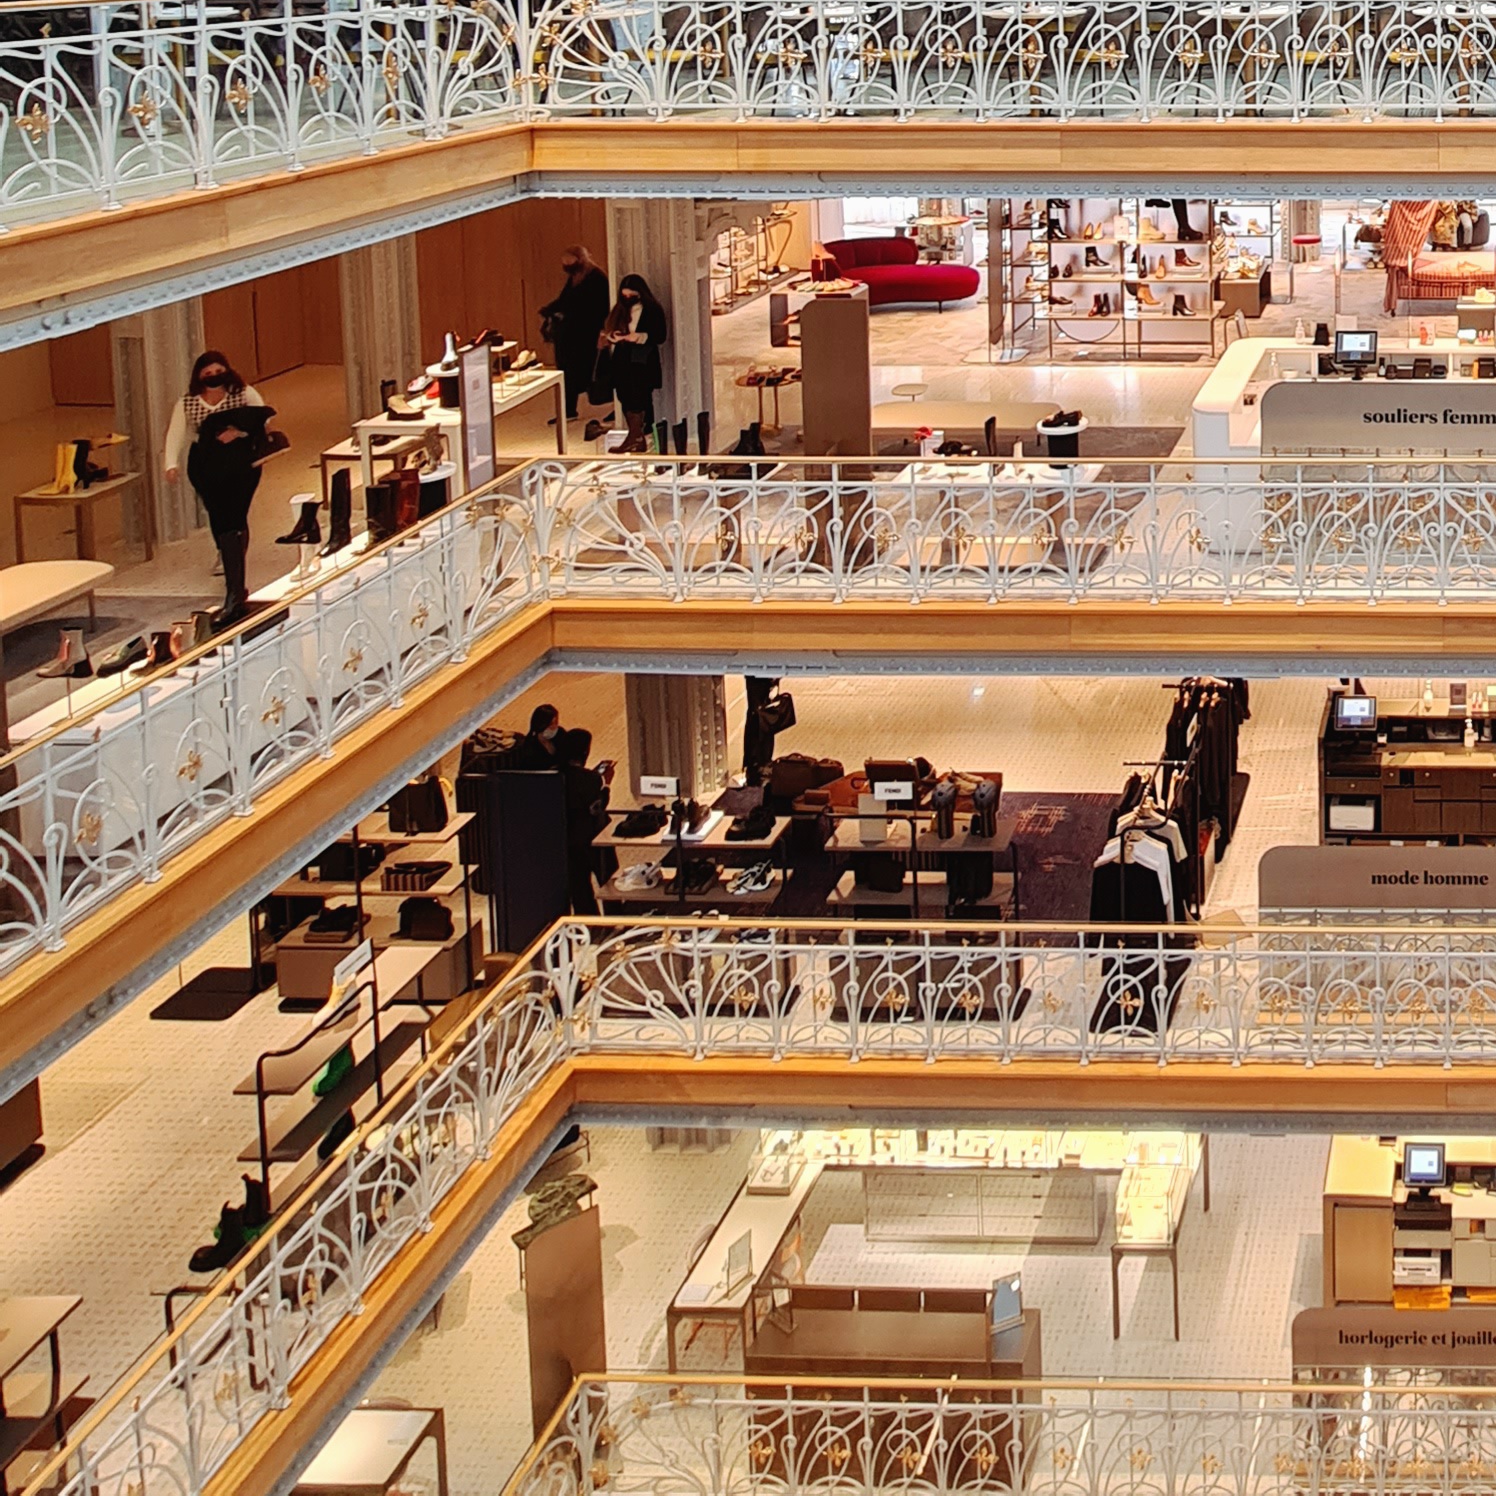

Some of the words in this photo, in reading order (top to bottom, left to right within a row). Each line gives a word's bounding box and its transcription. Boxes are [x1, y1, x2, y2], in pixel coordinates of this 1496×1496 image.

[1363, 408, 1438, 424] souliers
[1371, 870, 1420, 885] mode
[1423, 870, 1489, 886] homme
[1338, 1329, 1428, 1348] horlogerie
[1431, 1331, 1447, 1346] et
